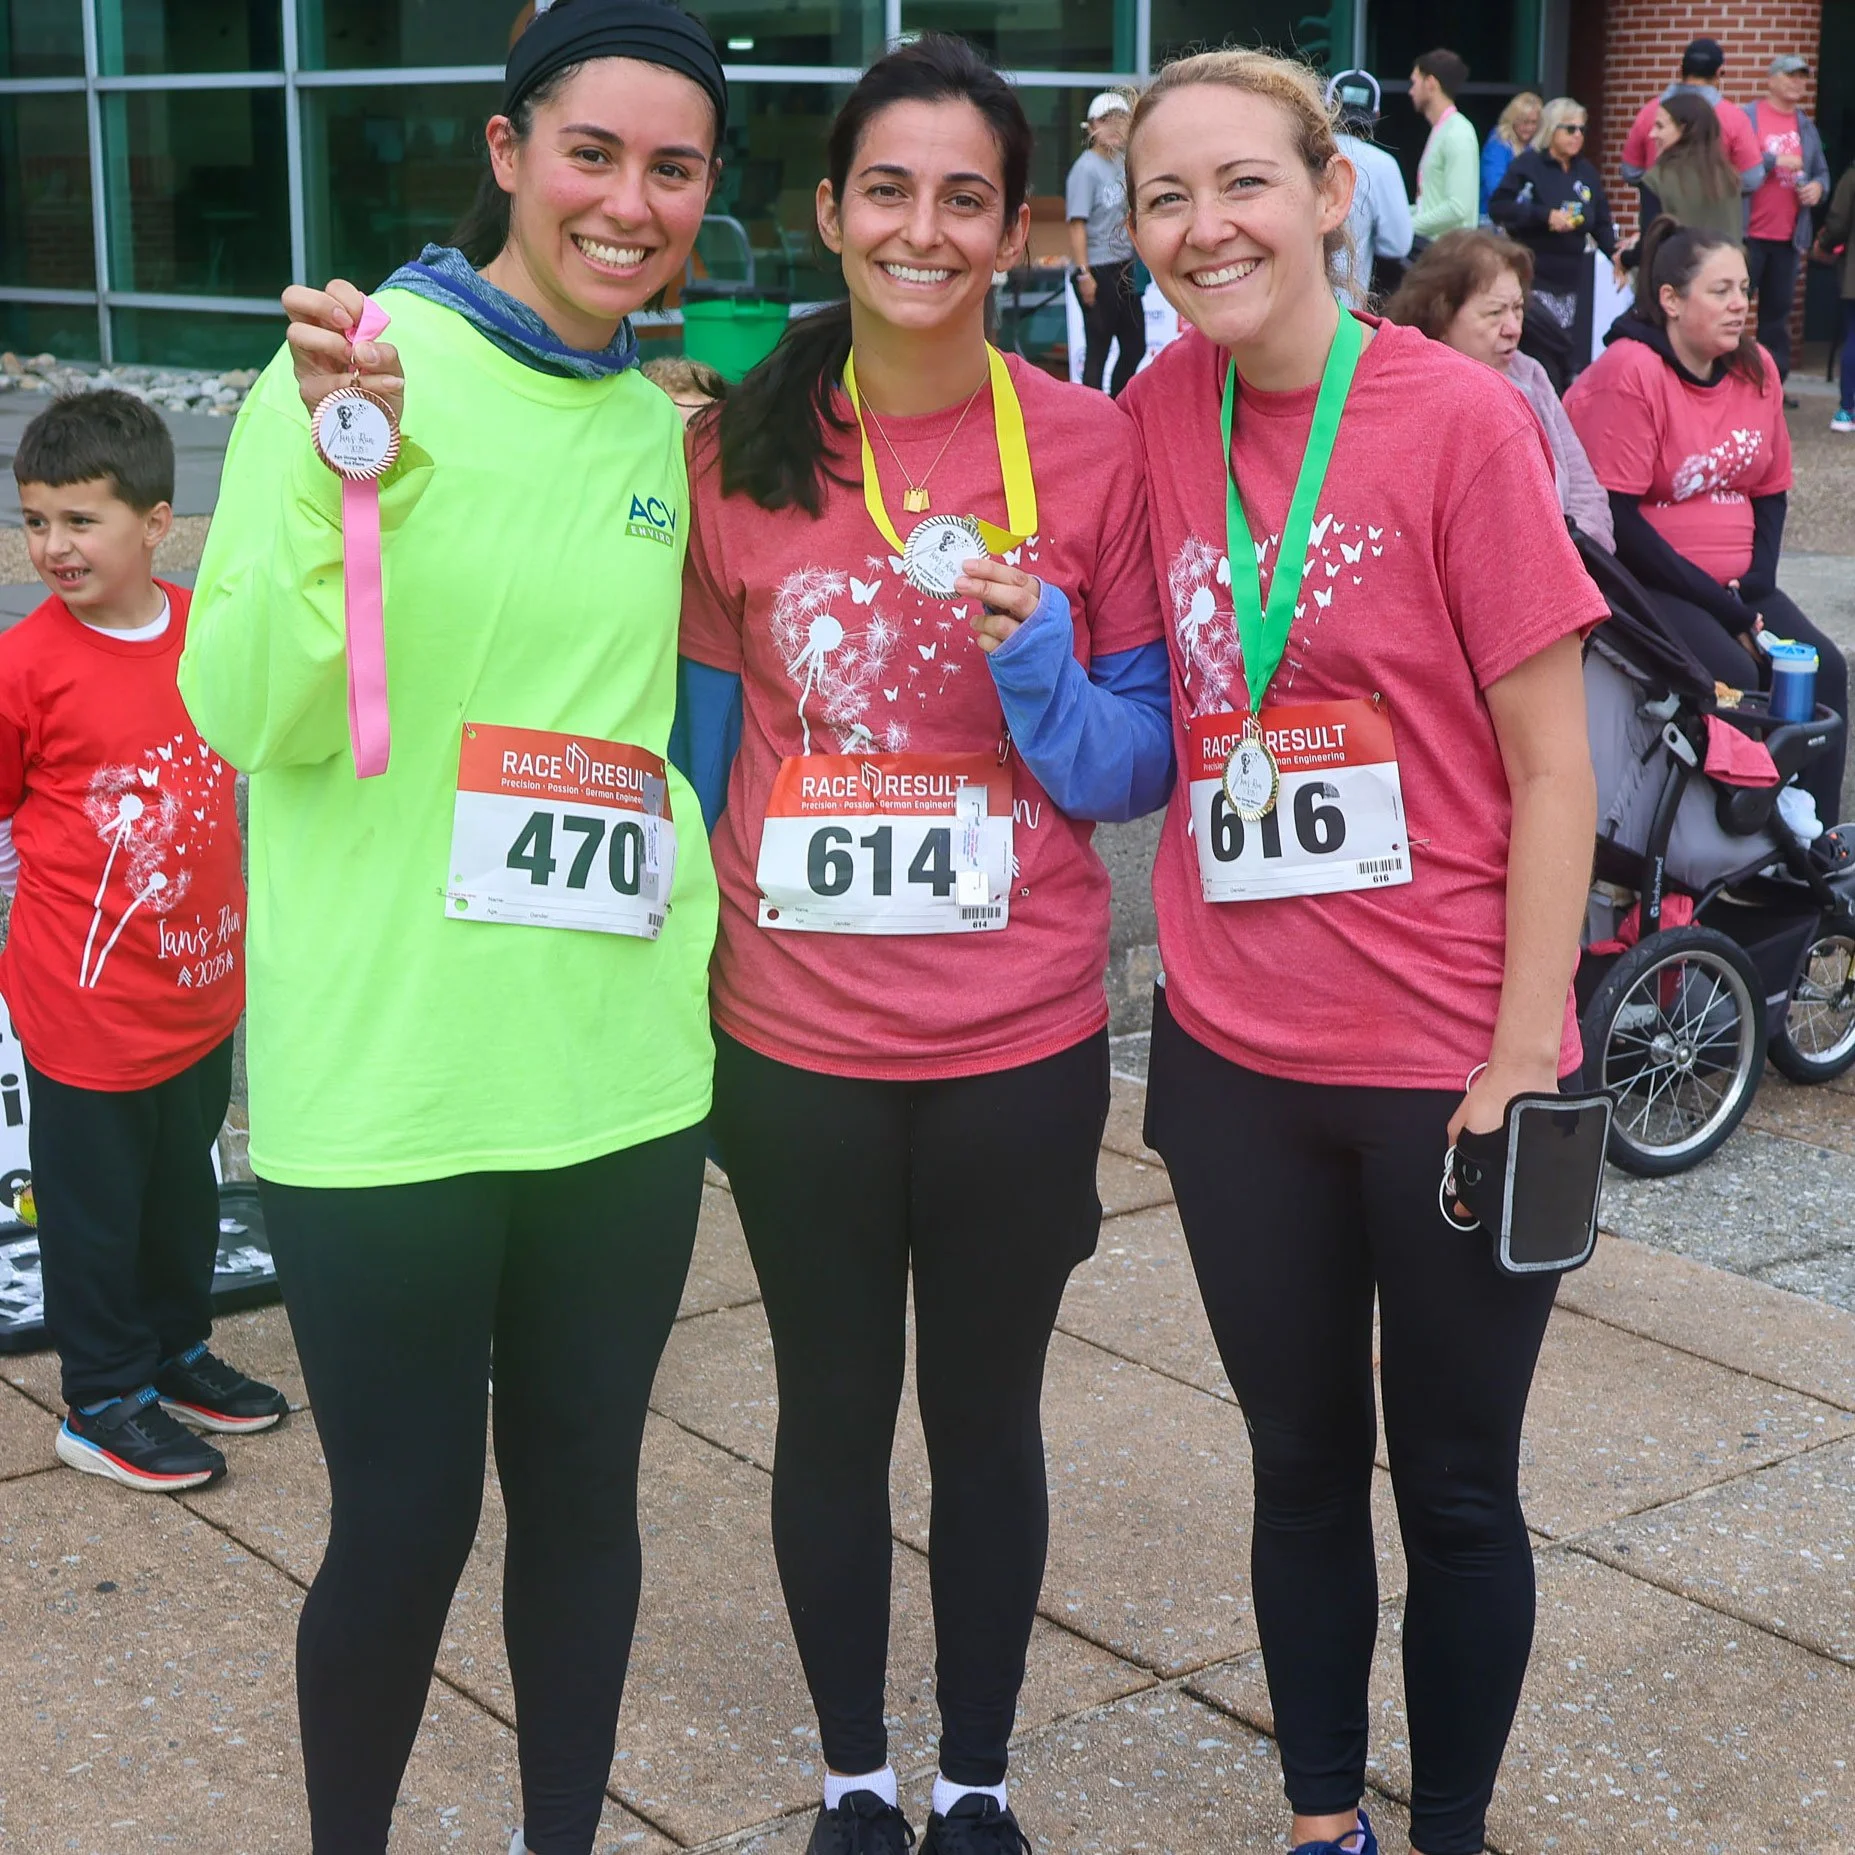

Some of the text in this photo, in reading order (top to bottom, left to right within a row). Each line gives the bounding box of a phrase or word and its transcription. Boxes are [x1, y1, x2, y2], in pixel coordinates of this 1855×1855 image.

[630, 525, 671, 545] ENVIRO
[1265, 724, 1346, 751] RESULT
[502, 750, 654, 791] RACE RESUL
[1293, 751, 1345, 767] Engineering
[501, 777, 541, 791] Precision
[547, 783, 579, 795] Passion
[585, 788, 614, 800] German
[802, 775, 969, 798] RACE RESULT
[801, 800, 837, 810] Precision
[843, 800, 875, 810] Passion
[880, 799, 912, 809] German
[1211, 781, 1346, 862] 616
[506, 811, 645, 896] 470
[807, 826, 956, 897] 614
[1373, 874, 1390, 884] 616
[158, 904, 240, 959] Ian's Run
[972, 921, 988, 929] 614
[194, 952, 227, 988] 2025
